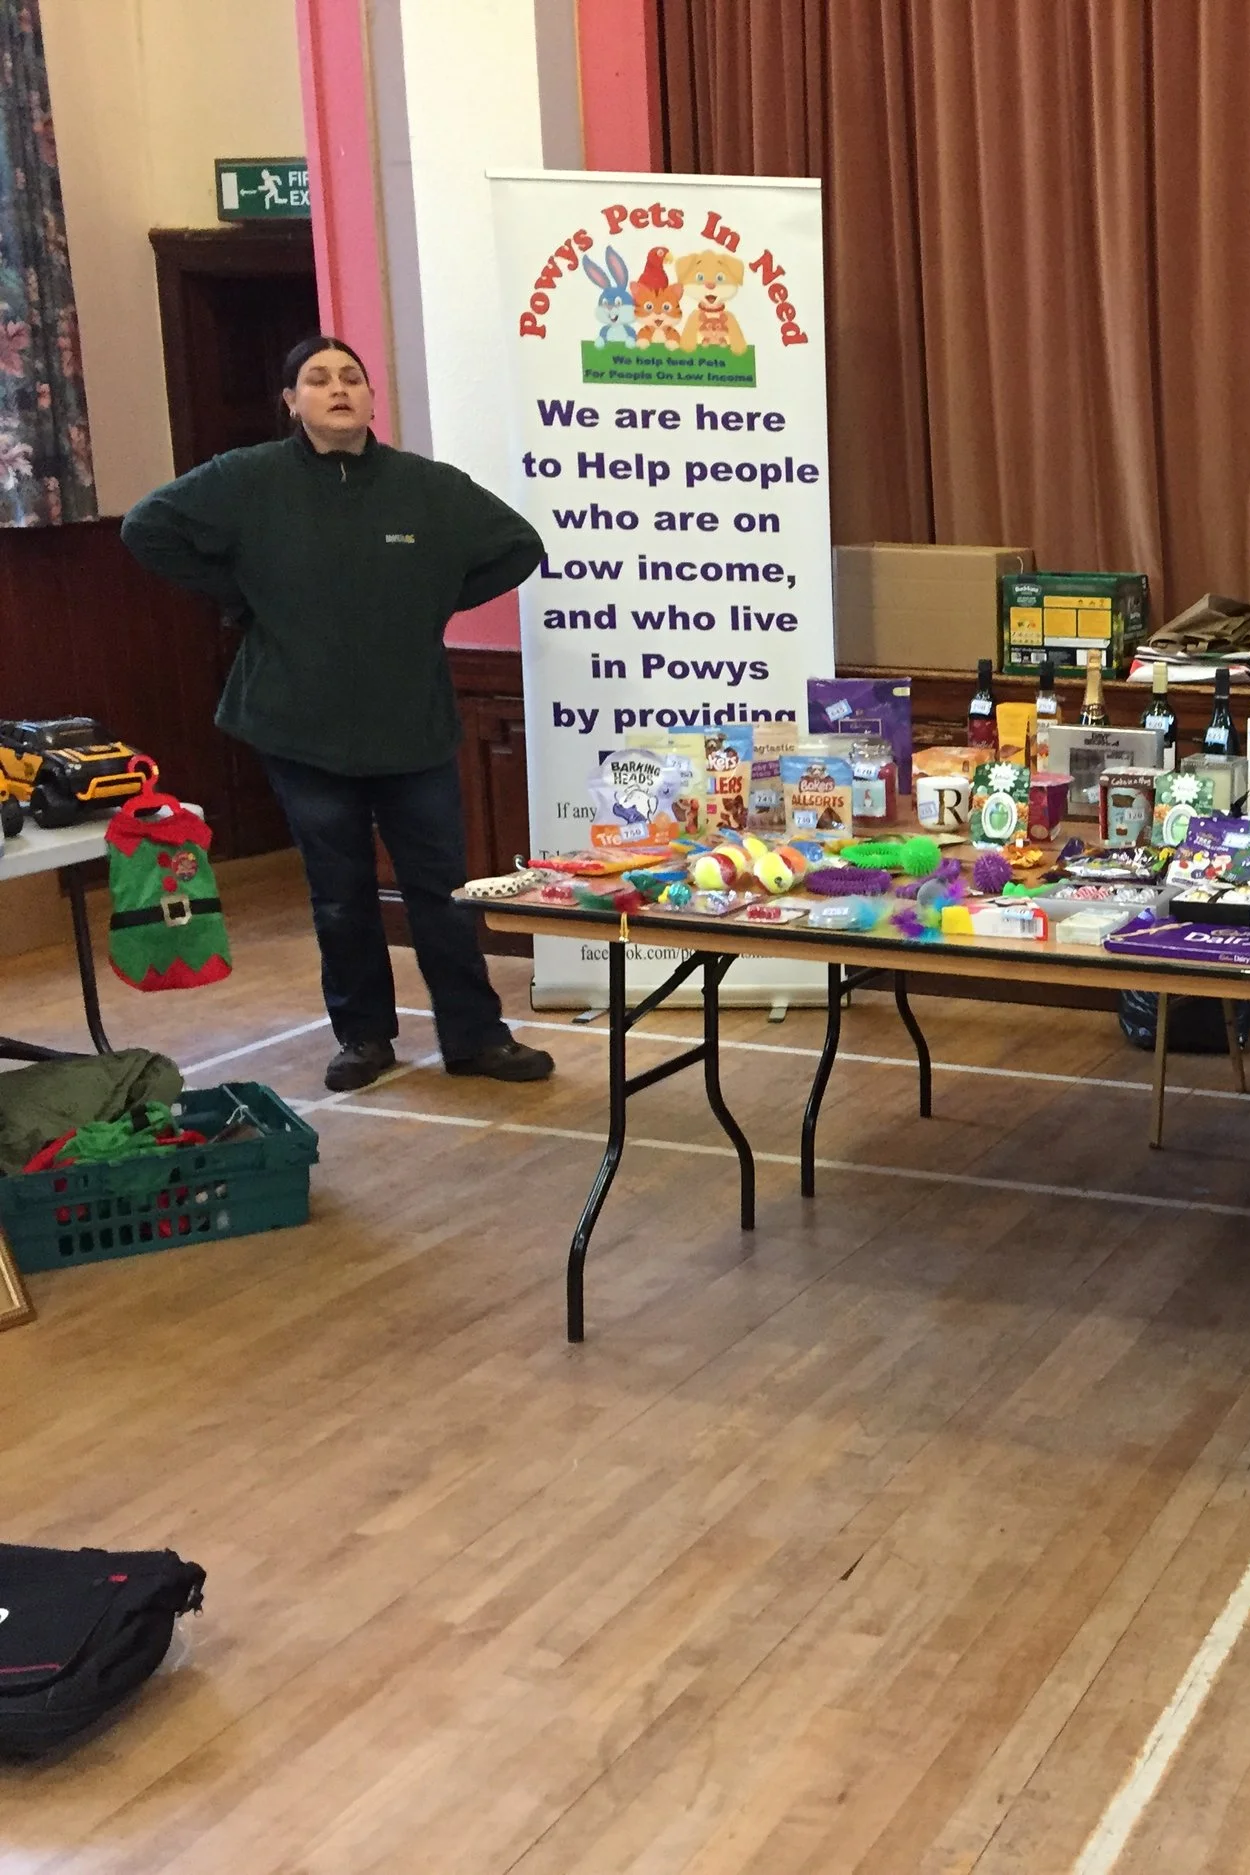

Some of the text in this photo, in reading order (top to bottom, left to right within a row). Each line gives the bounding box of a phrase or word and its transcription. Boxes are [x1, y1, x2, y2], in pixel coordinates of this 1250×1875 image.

[290, 190, 310, 206] EX
[519, 202, 809, 347] Powys Pets In Need
[612, 356, 726, 368] We help feed Pets
[584, 369, 753, 382] For People On Low Income
[537, 399, 786, 432] We are here
[522, 452, 819, 489] to Help people
[552, 503, 780, 533] who are on
[540, 554, 796, 589] Low income,
[543, 604, 798, 632] and who live
[591, 653, 769, 686] in Powys
[552, 701, 796, 734] by providing
[753, 744, 796, 754] agtastic
[611, 761, 661, 777] BARKING
[614, 772, 654, 787] HEADS
[800, 779, 834, 793] Bakers
[557, 802, 597, 822] If any
[792, 794, 844, 808] ALLSORTS
[933, 788, 964, 826] R
